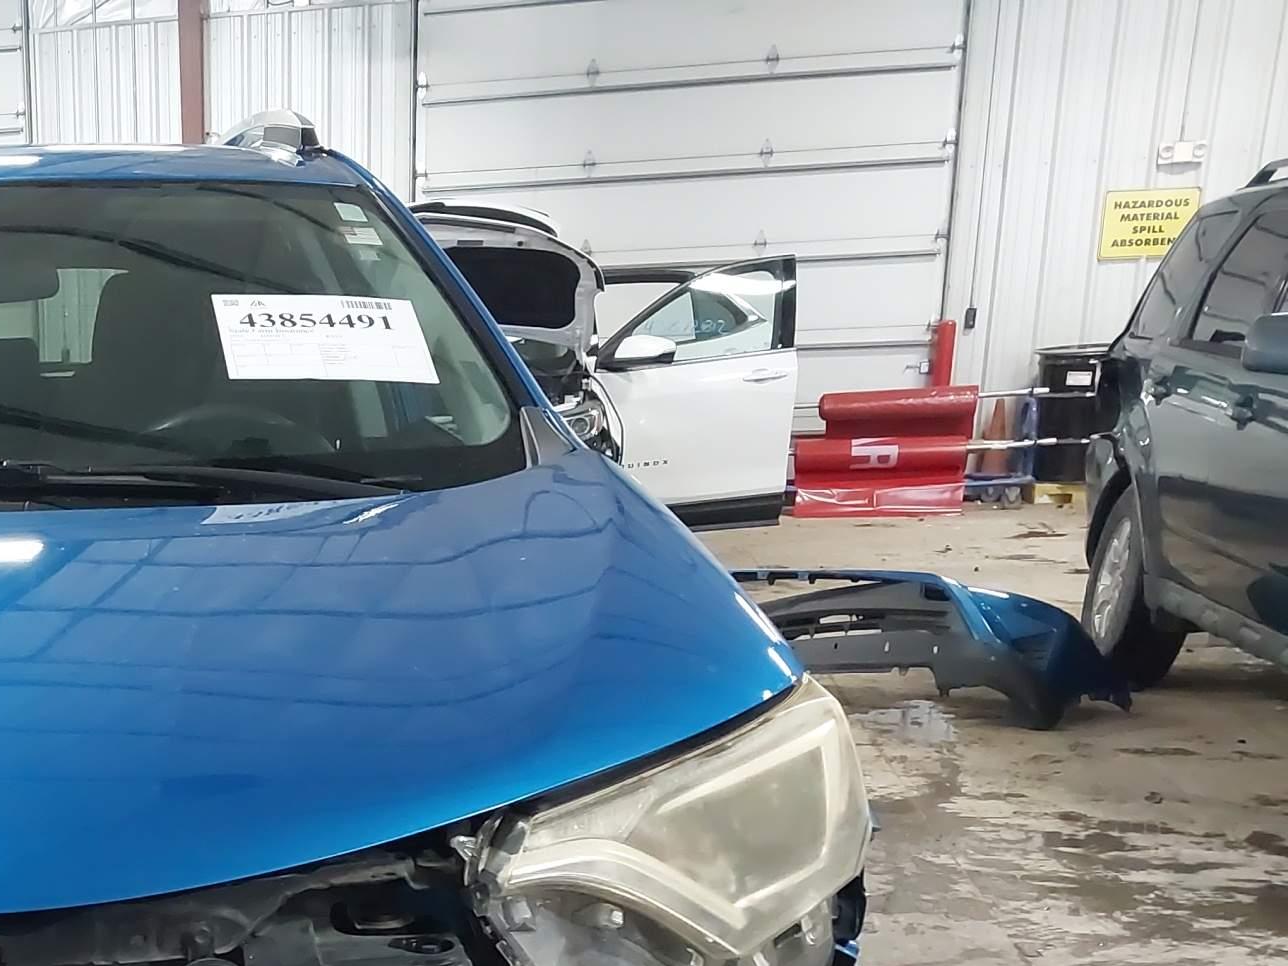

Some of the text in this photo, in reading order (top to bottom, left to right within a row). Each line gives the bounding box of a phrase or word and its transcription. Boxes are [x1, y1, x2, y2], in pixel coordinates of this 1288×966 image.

[1114, 198, 1190, 209] HAZARDOUS
[1120, 212, 1180, 222] MATERIAL
[1132, 225, 1165, 234] SPILL
[1111, 237, 1176, 247] ABSORBEN
[239, 312, 394, 331] 43854491
